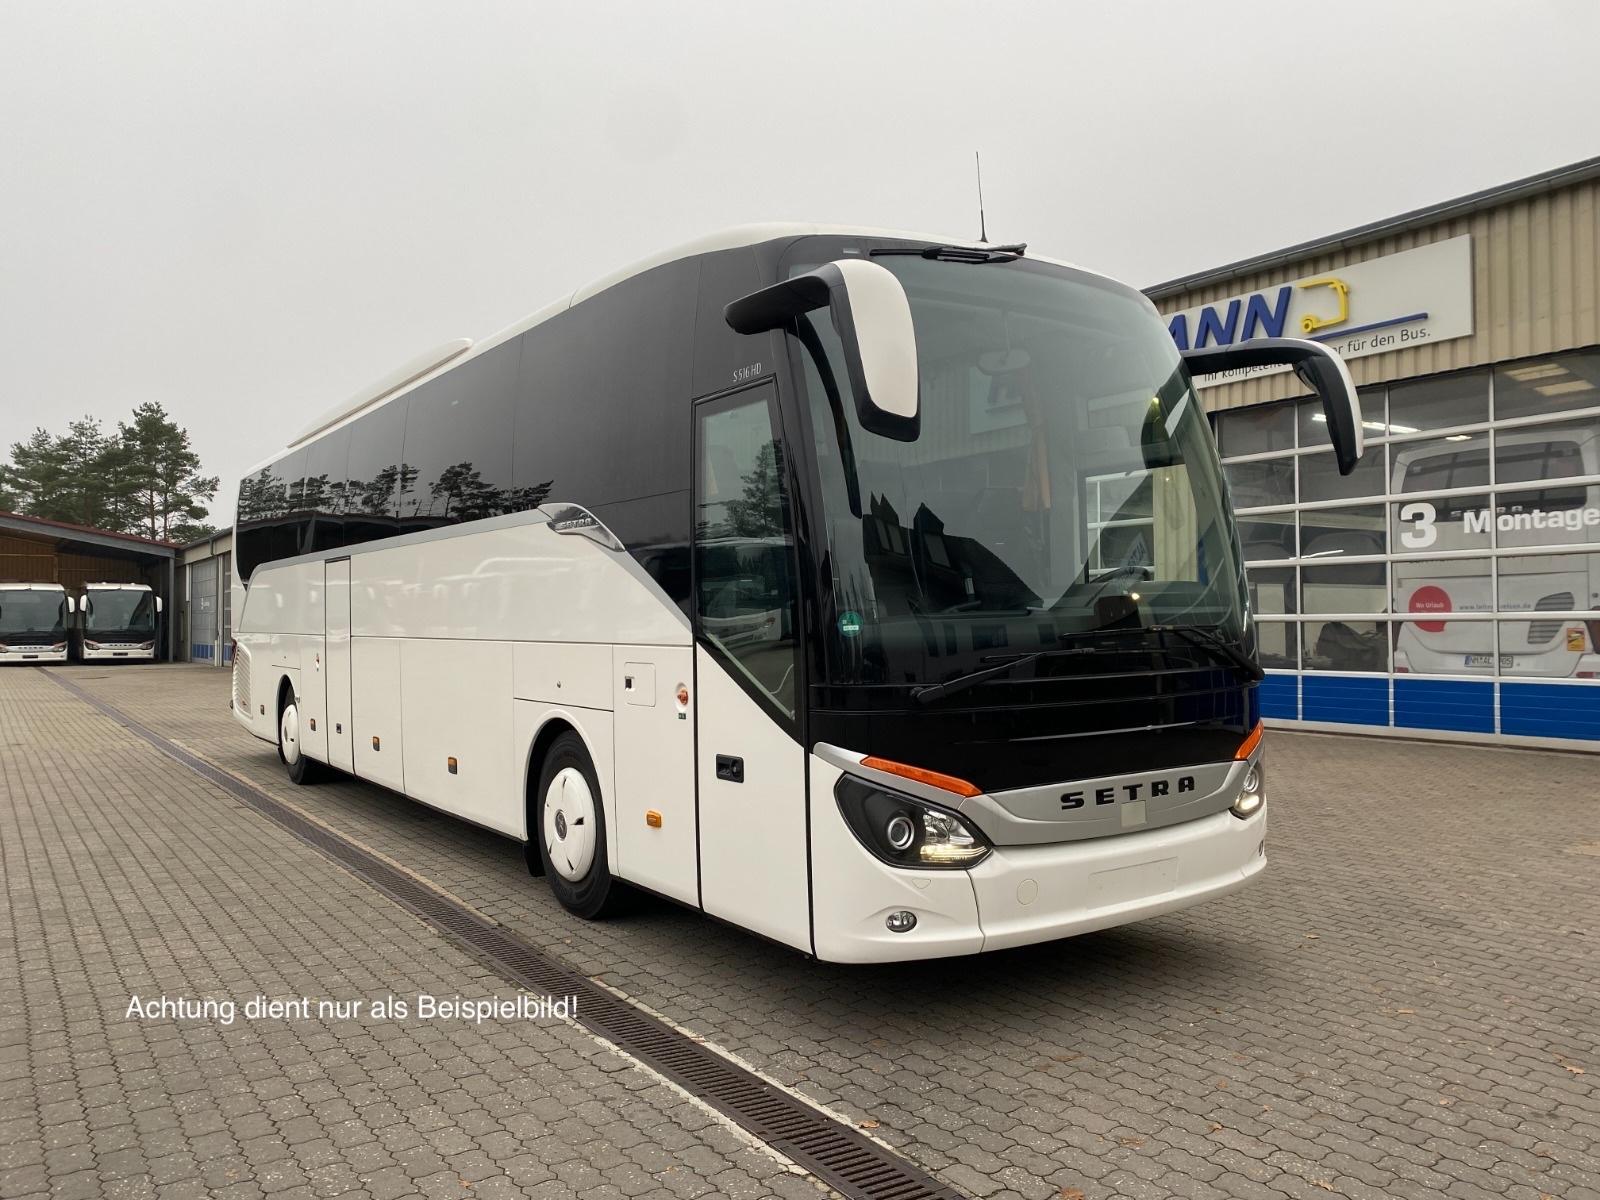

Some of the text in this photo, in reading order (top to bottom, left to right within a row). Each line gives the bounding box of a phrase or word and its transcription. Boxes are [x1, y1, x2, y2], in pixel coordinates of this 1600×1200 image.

[1347, 338, 1368, 353] für
[1370, 334, 1396, 348] den
[1400, 328, 1432, 342] Bus.
[1400, 502, 1600, 549] 3 Montage
[1060, 776, 1195, 811] SETRA
